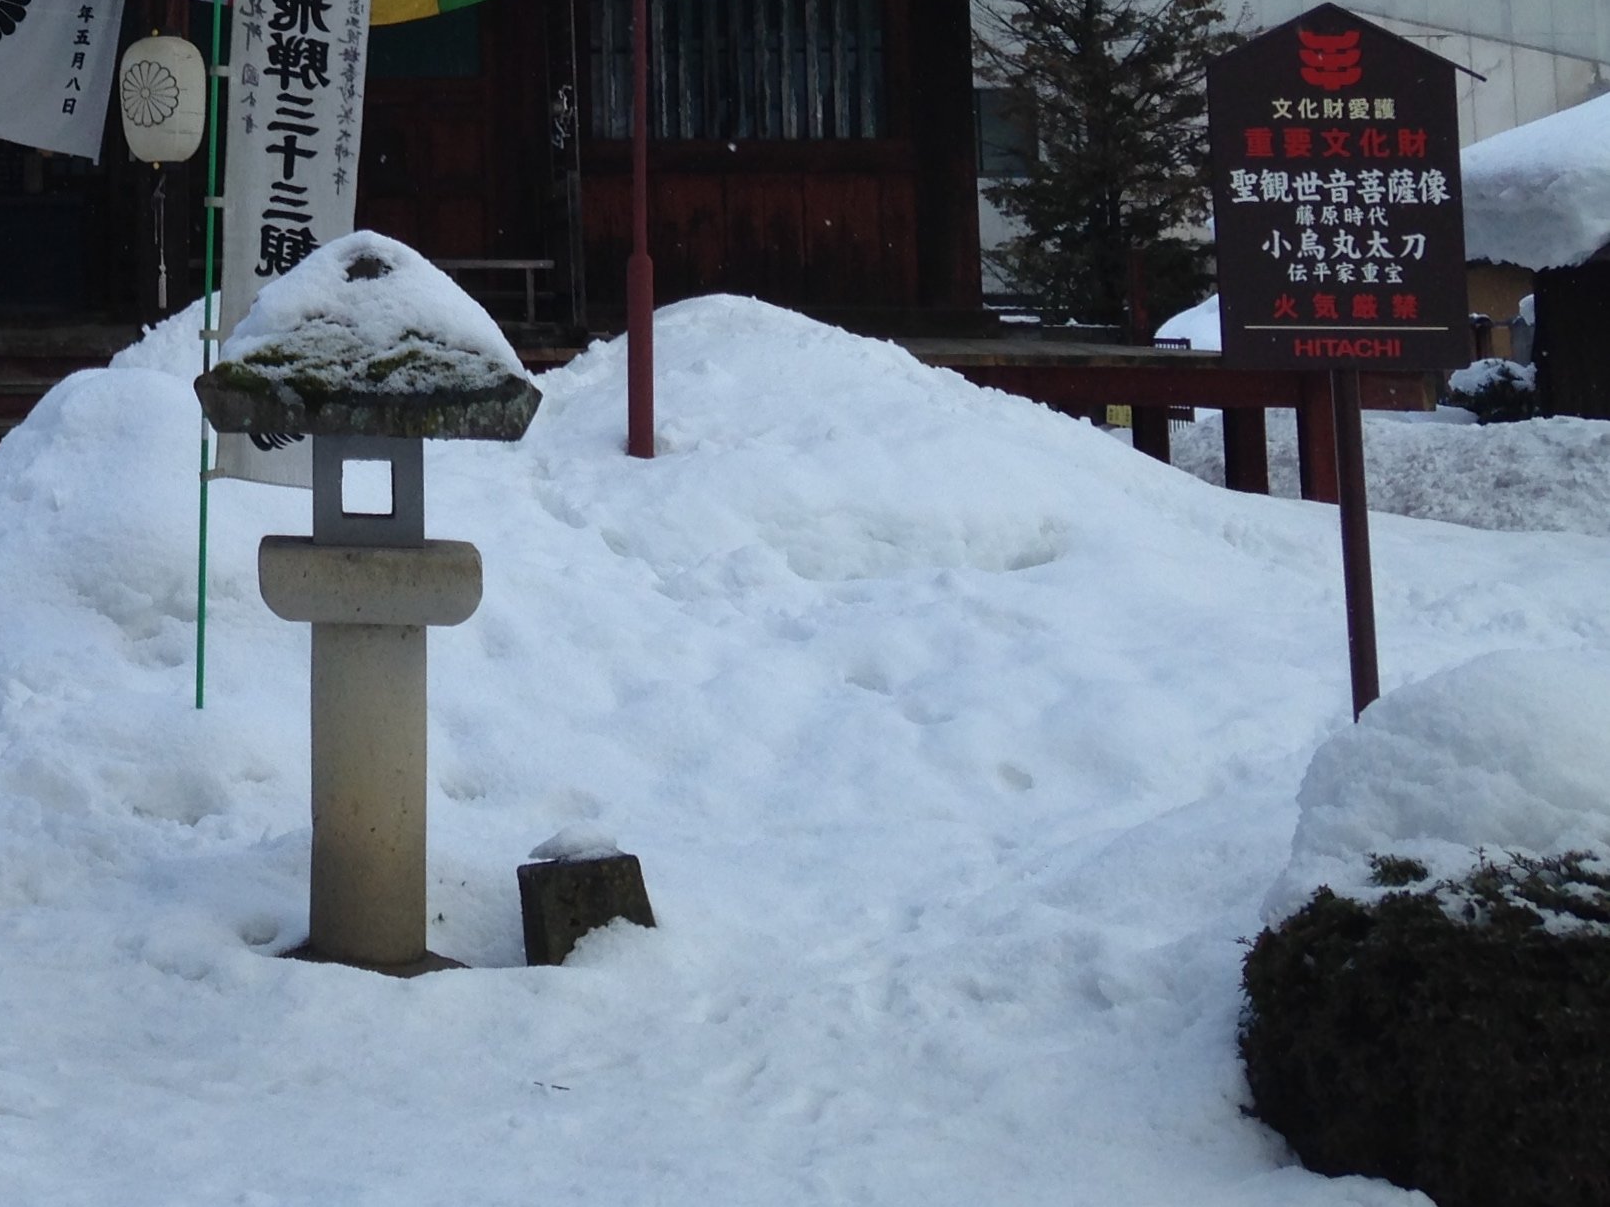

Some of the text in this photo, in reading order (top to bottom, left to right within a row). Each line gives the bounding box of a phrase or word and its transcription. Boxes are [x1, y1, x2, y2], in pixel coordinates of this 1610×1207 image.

[1272, 98, 1395, 119] 文化財愛護
[1245, 128, 1427, 157] 重要文化財
[1231, 168, 1450, 203] 聖観世音菩薩像
[1295, 204, 1389, 227] 藤原時代
[1261, 229, 1426, 260] 小烏丸太刀
[1287, 262, 1404, 284] 伝平家重宝
[1273, 293, 1419, 320] 火気厳禁
[1294, 338, 1402, 358] HITACHI
